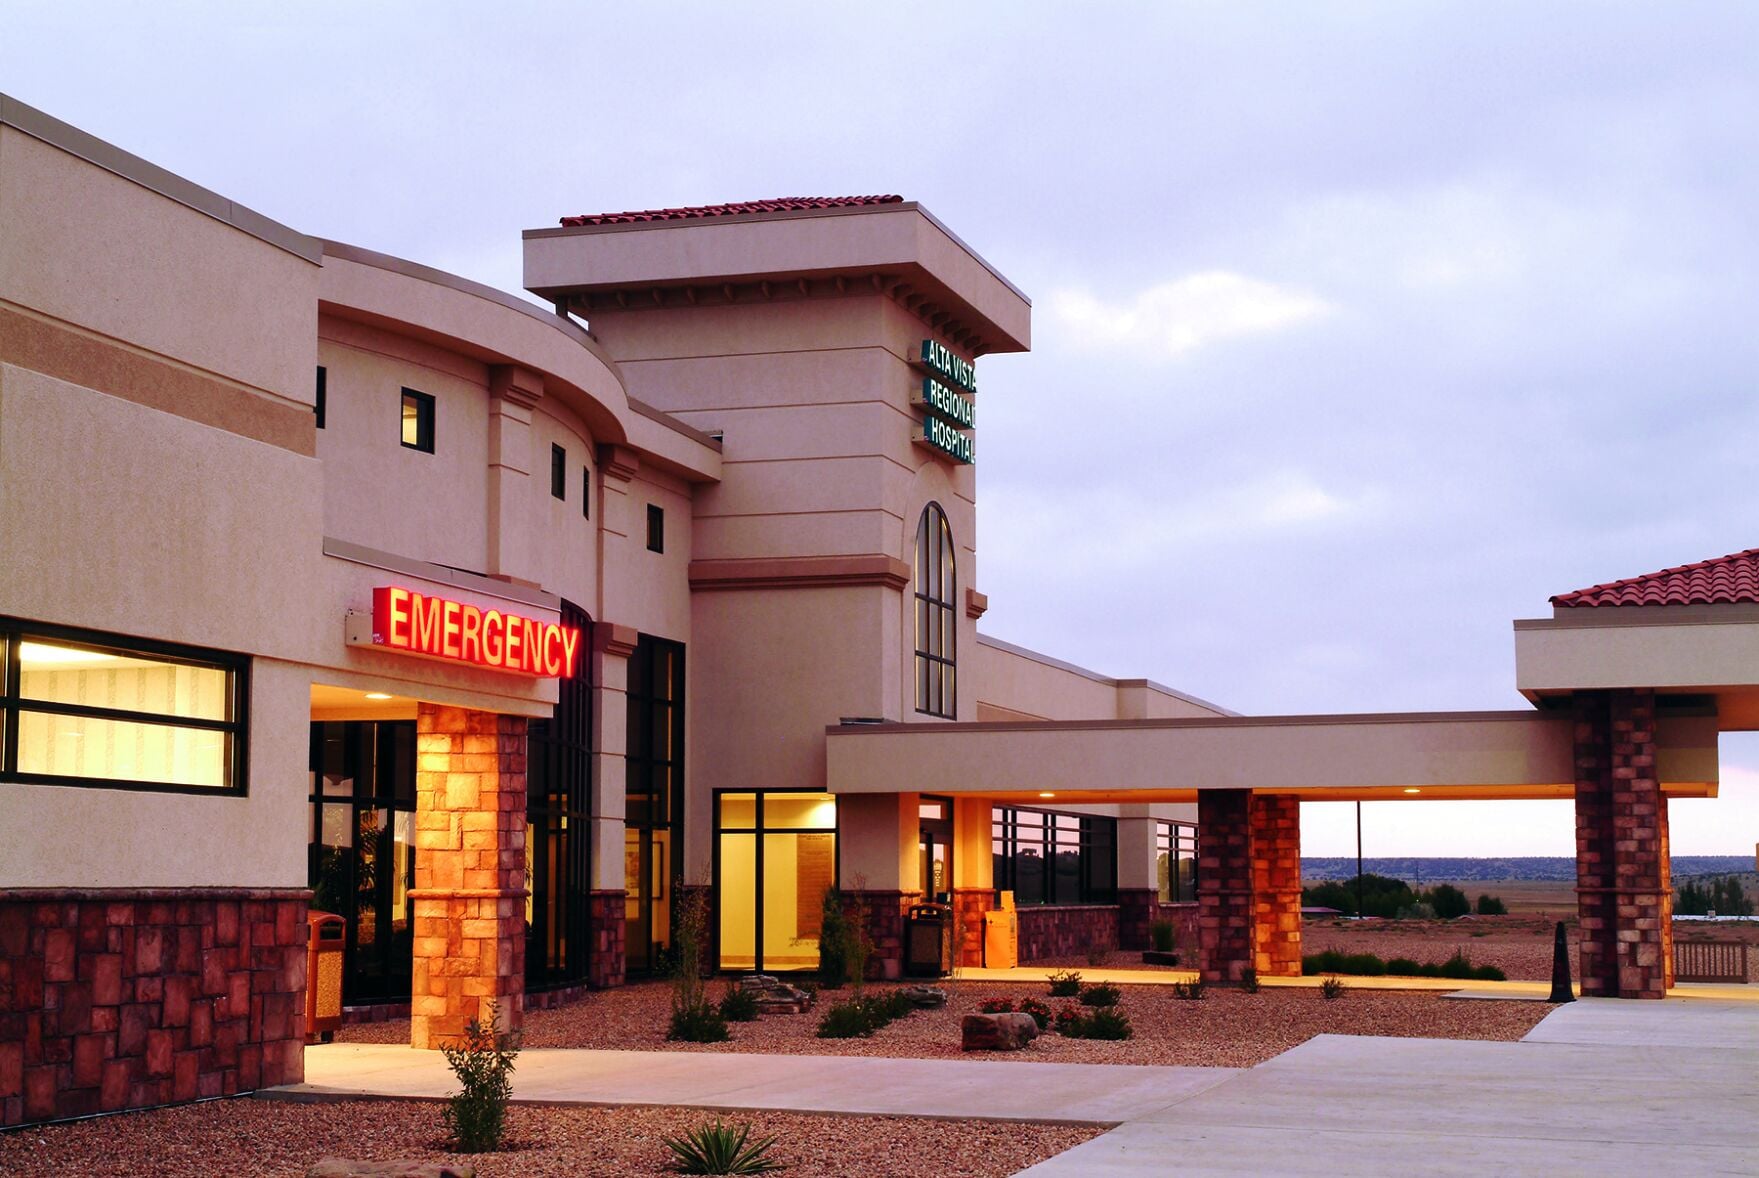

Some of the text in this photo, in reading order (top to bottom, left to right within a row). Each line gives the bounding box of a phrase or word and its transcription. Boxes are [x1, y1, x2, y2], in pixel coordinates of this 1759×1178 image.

[928, 340, 976, 389] ALTA VISTA
[930, 379, 976, 429] REGIONAL
[931, 417, 976, 464] HOSPITAL
[389, 587, 579, 678] EMERGENCY
